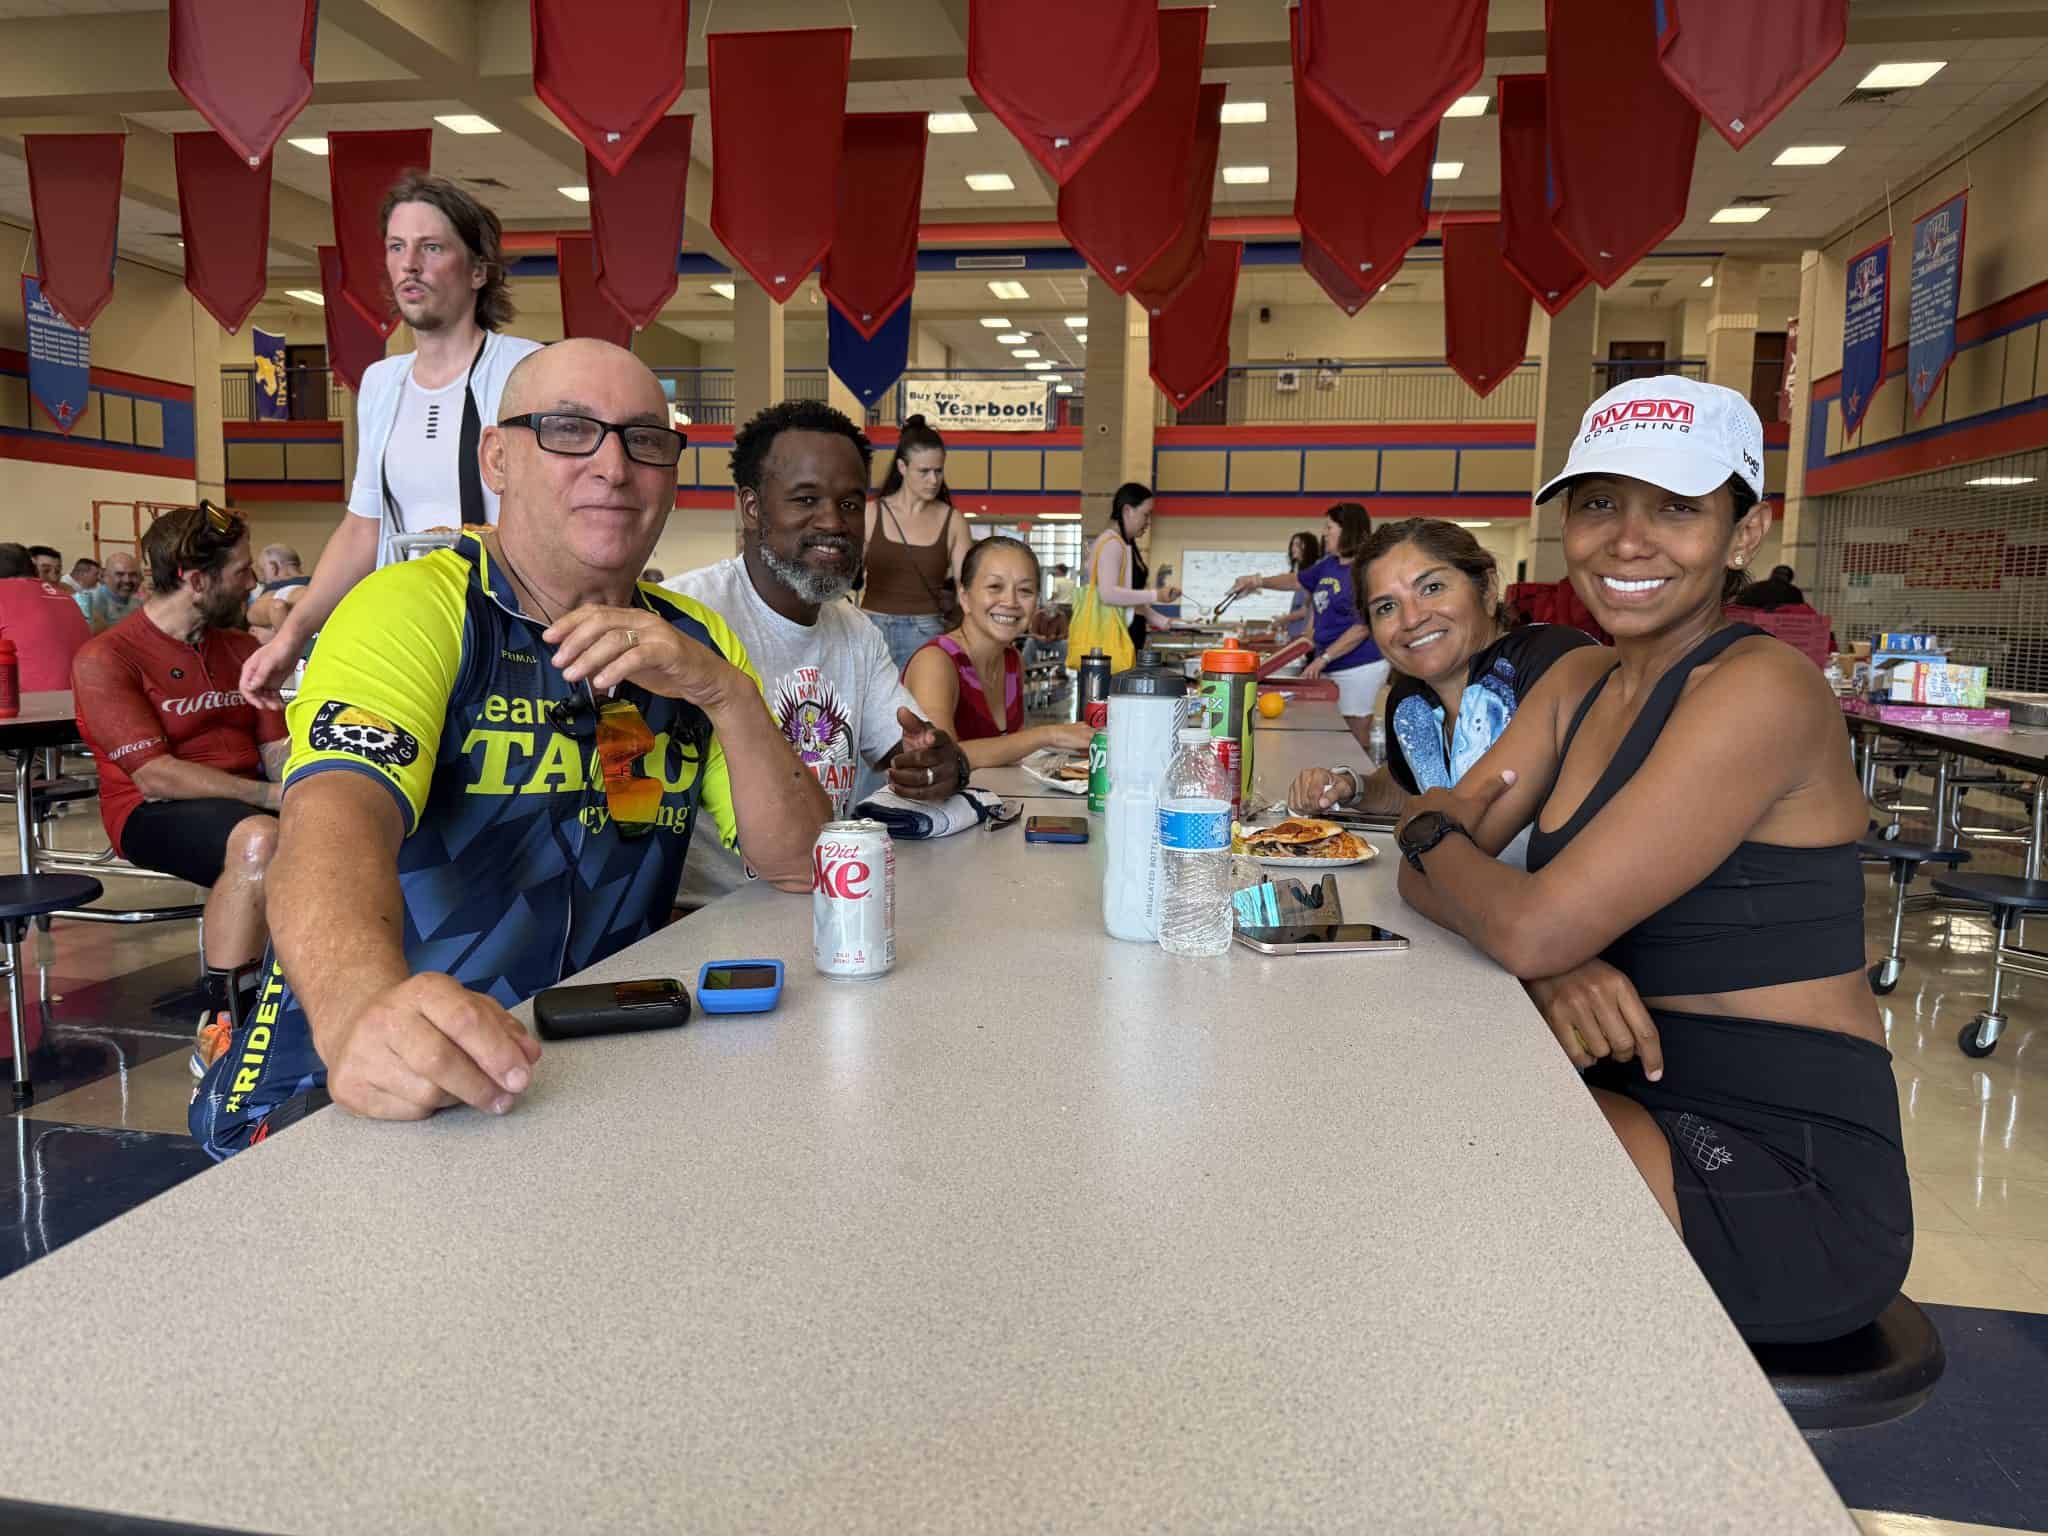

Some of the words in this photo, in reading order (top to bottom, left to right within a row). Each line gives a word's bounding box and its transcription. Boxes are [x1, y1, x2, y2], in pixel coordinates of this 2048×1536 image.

[935, 391, 961, 400] Your
[935, 401, 1043, 416] Yearbook
[1590, 400, 1693, 432] NVDM
[1584, 421, 1690, 444] COACHING
[476, 694, 575, 726] ea
[461, 729, 699, 794] TAO
[578, 805, 691, 834] cyng
[824, 841, 859, 858] Diet
